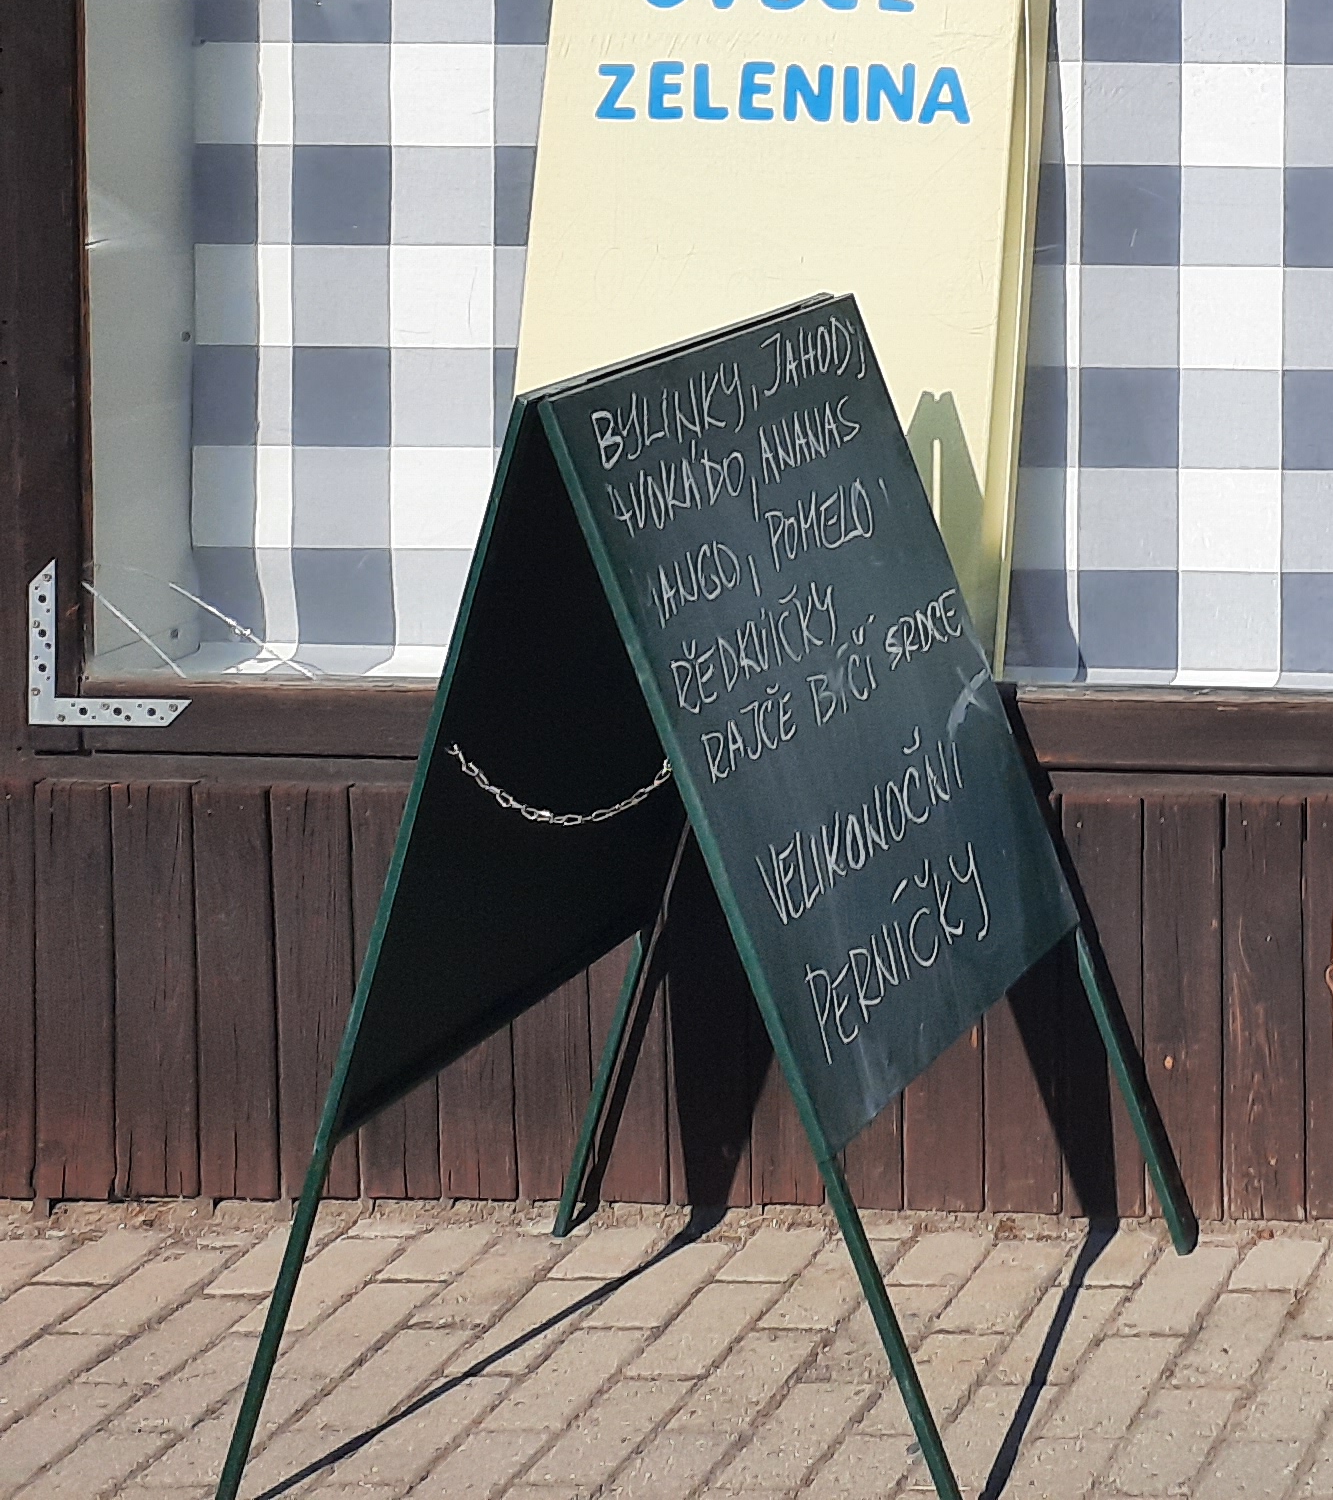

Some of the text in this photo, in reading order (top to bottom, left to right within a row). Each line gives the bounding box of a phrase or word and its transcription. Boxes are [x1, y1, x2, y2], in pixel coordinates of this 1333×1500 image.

[595, 61, 971, 124] ZELENINA
[757, 395, 861, 485] ANANAS
[764, 477, 875, 573] POMELO
[700, 682, 798, 784] RAJČE
[885, 587, 962, 671] SRDCE
[804, 841, 991, 1065] PERNÍČKY
